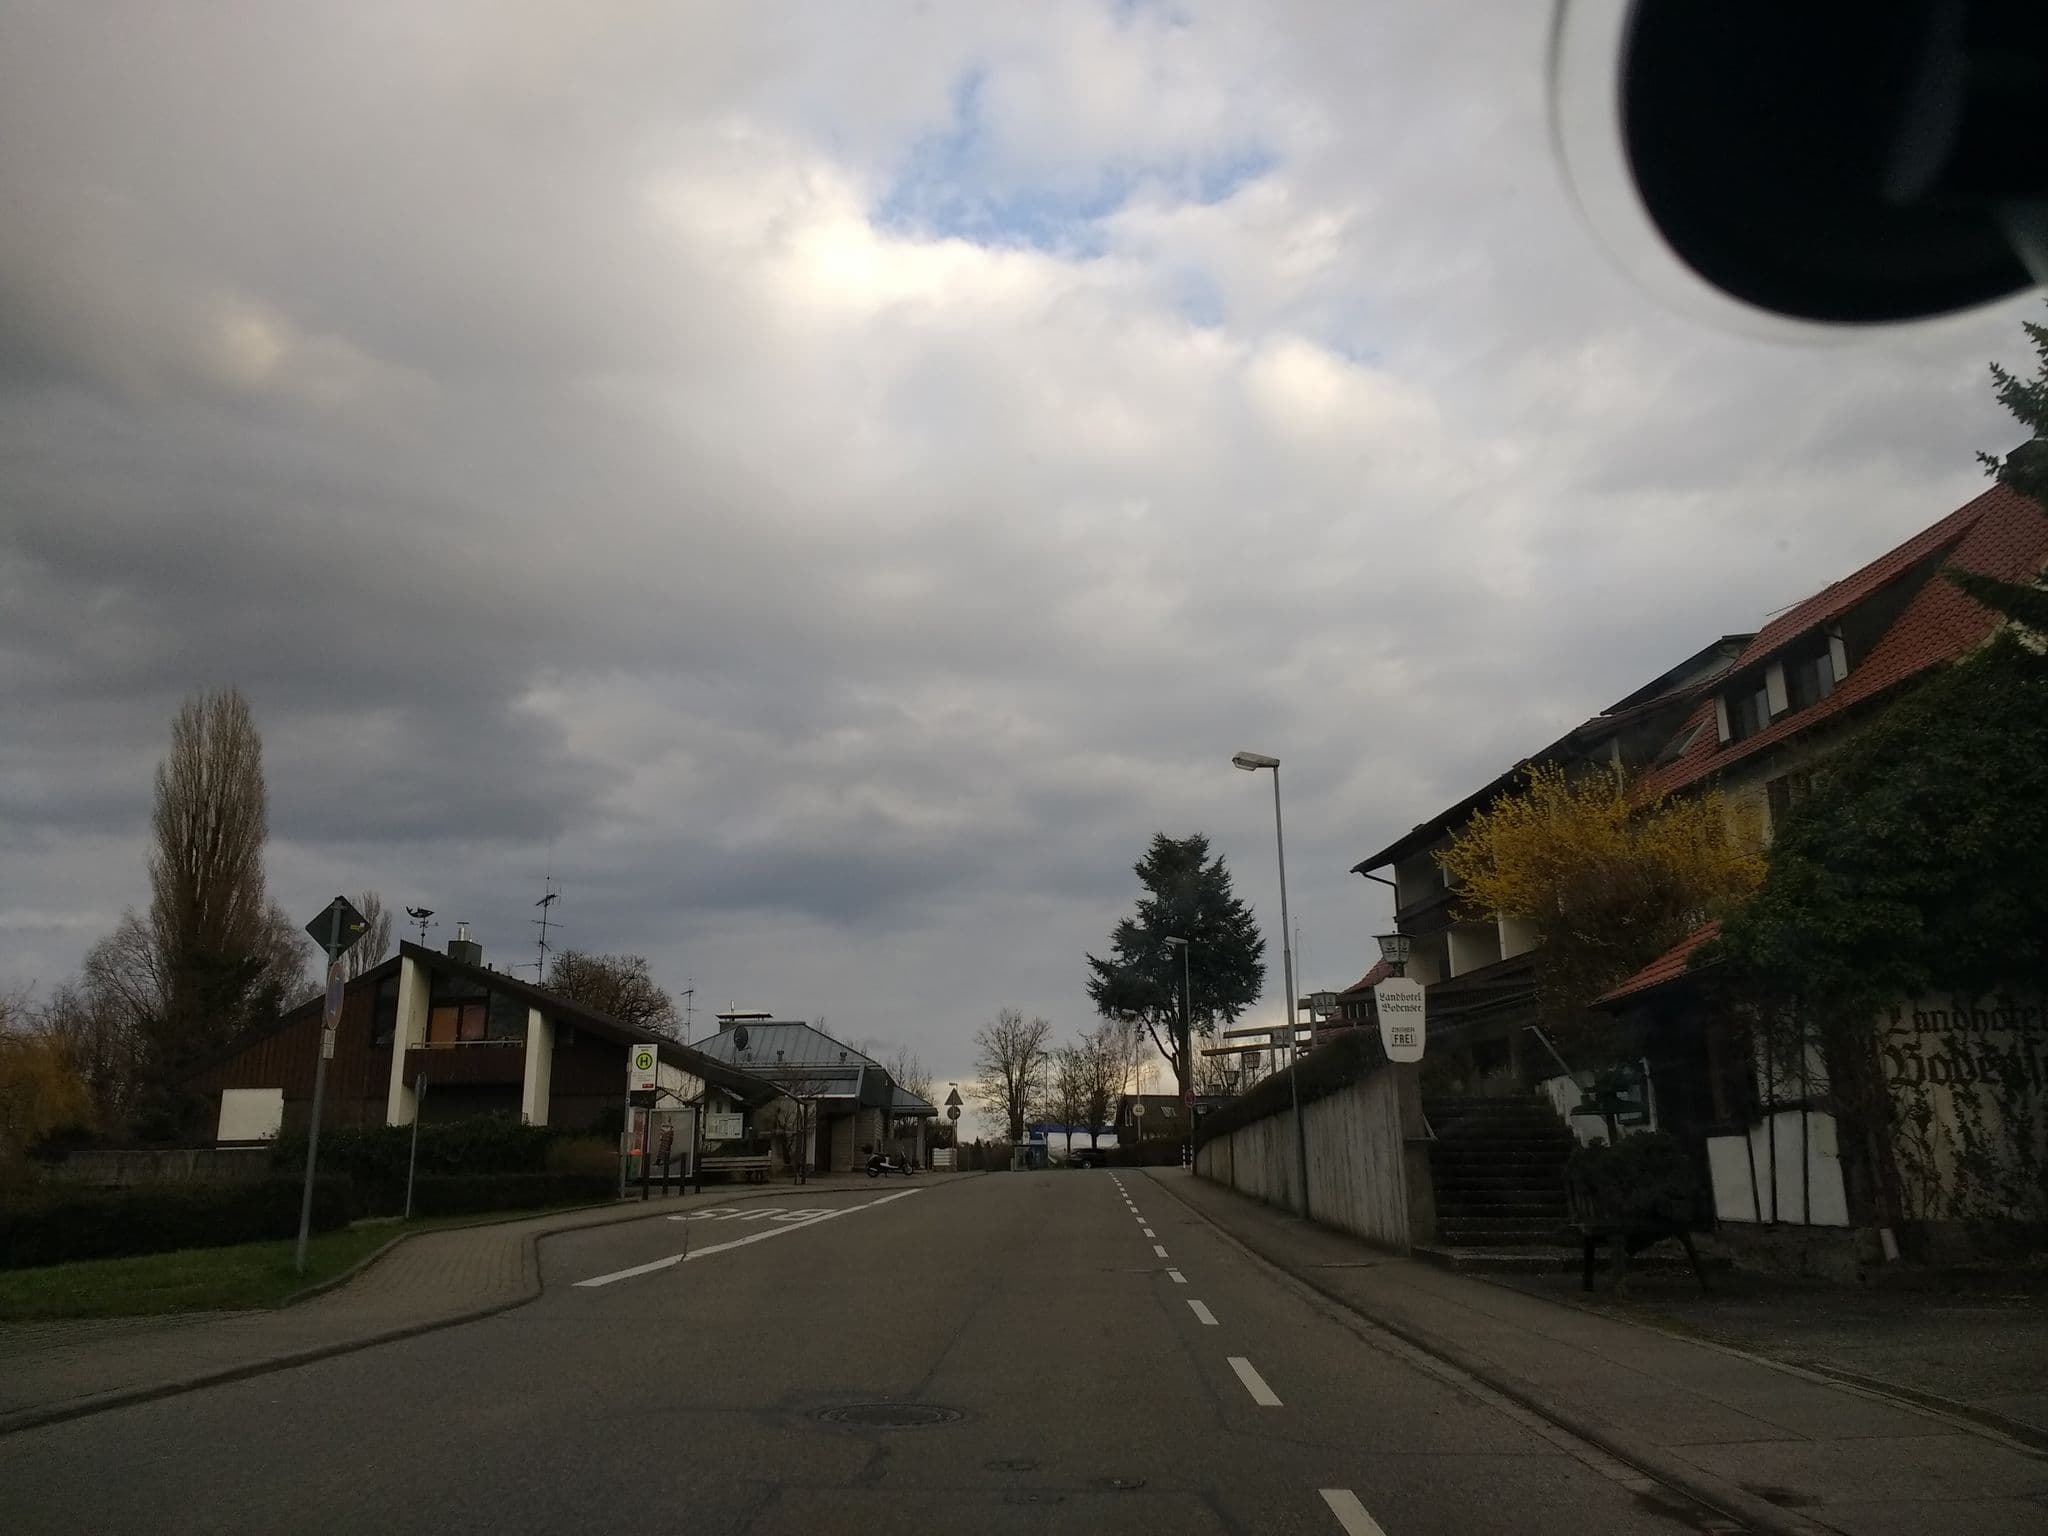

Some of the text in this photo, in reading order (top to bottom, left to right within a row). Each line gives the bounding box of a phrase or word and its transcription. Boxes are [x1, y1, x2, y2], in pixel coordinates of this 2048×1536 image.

[1379, 992, 1422, 1002] Landhotel
[1381, 1003, 1422, 1013] Bodensee
[1394, 1034, 1414, 1044] FREI
[640, 1056, 648, 1066] H
[666, 1208, 838, 1221] BUS
